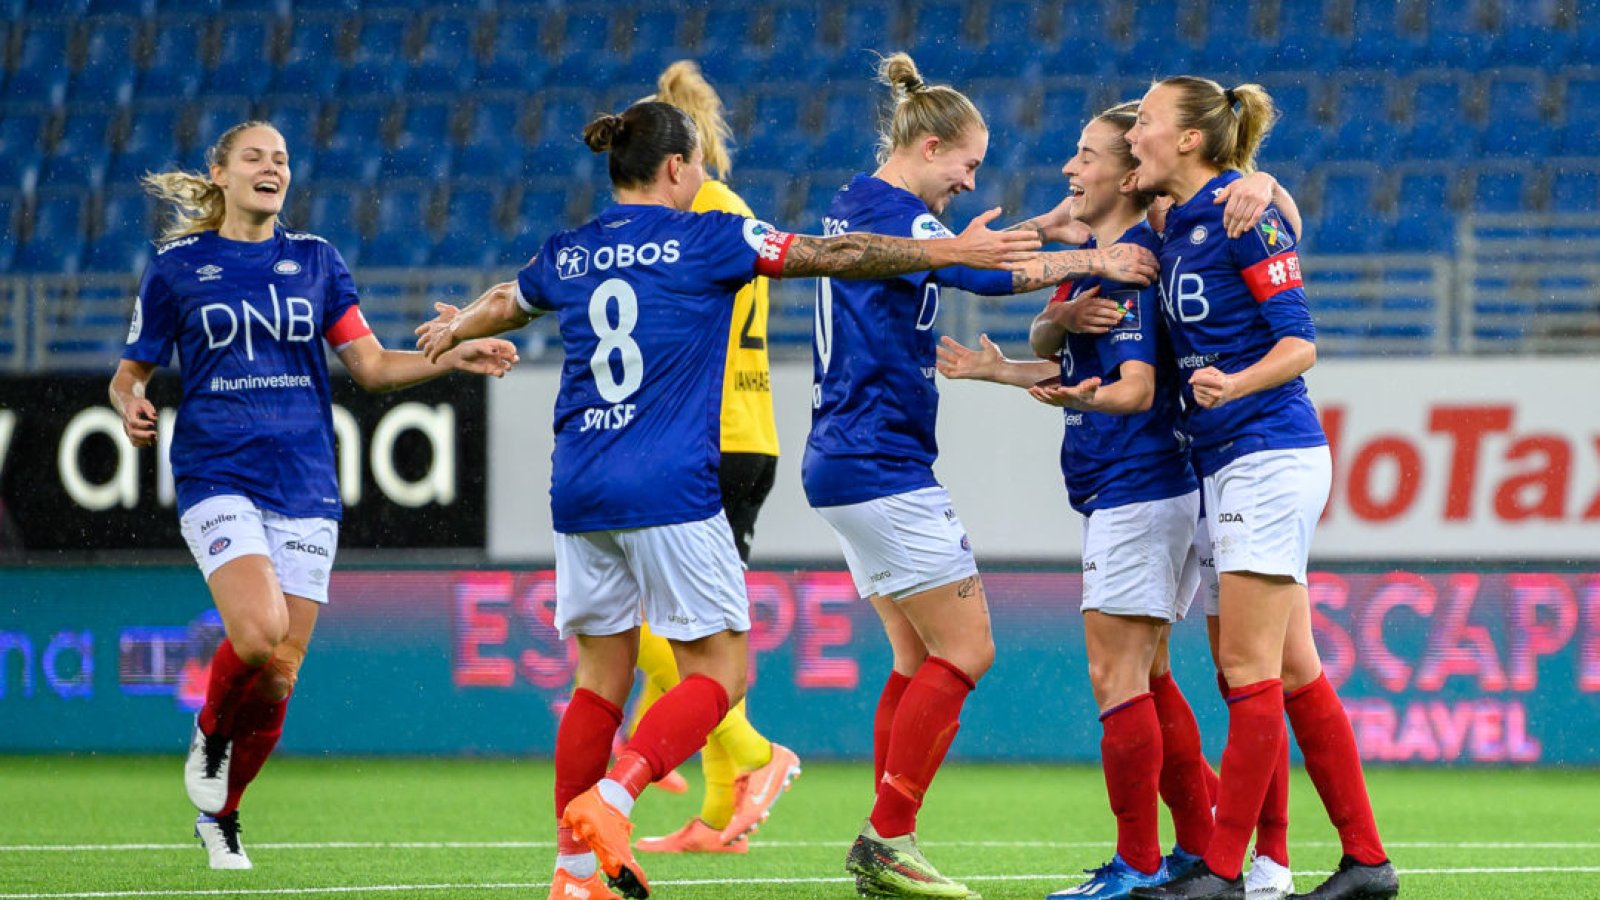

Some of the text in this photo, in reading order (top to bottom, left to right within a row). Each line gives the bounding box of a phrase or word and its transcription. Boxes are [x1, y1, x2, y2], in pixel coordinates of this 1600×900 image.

[593, 239, 681, 271] OBOS
[201, 284, 315, 361] DNB
[588, 277, 644, 404] 8
[211, 374, 313, 392] #huninvesterer
